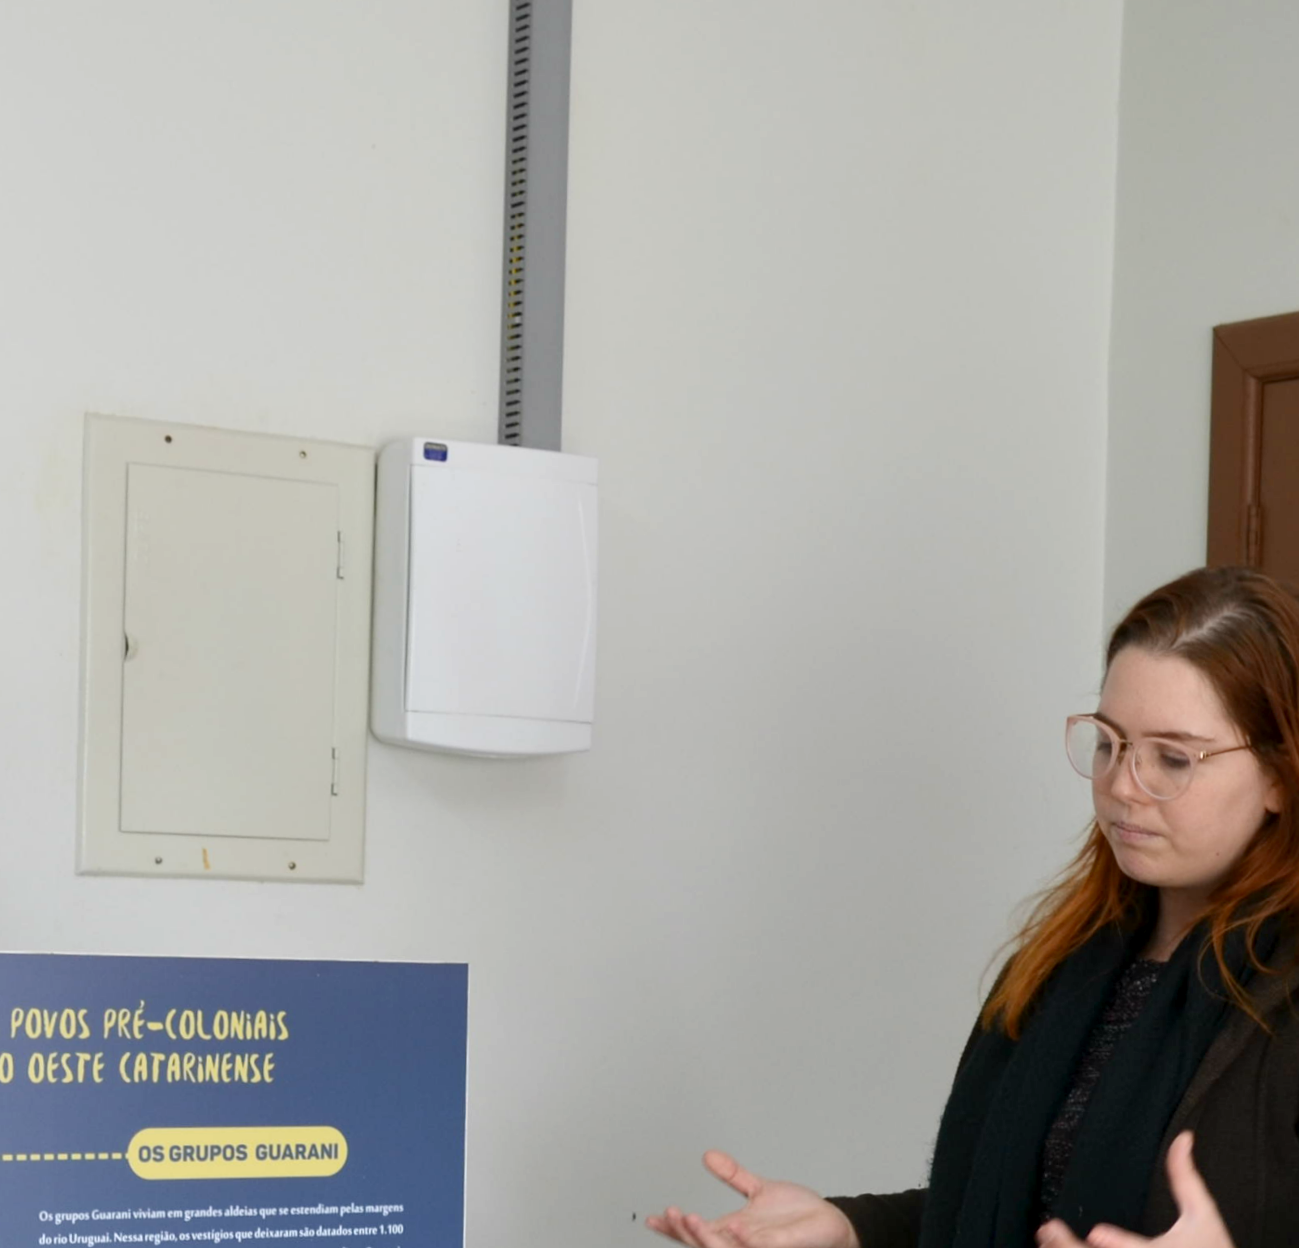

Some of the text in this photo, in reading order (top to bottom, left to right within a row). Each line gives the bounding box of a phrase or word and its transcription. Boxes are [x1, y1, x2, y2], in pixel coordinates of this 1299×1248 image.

[10, 1008, 91, 1039] POVOS
[27, 1052, 105, 1083] OESTE
[119, 1052, 275, 1084] CATARINENSE
[138, 1142, 338, 1163] OS GRUPOS GUARANI
[38, 1202, 404, 1225] Os grupos Guarani viviam em grandes aldeias que se estendiam pelas margens
[38, 1223, 403, 1248] do rio Uruguai. Nessa região, os vestígios que deixaram são datados entre 1.100
